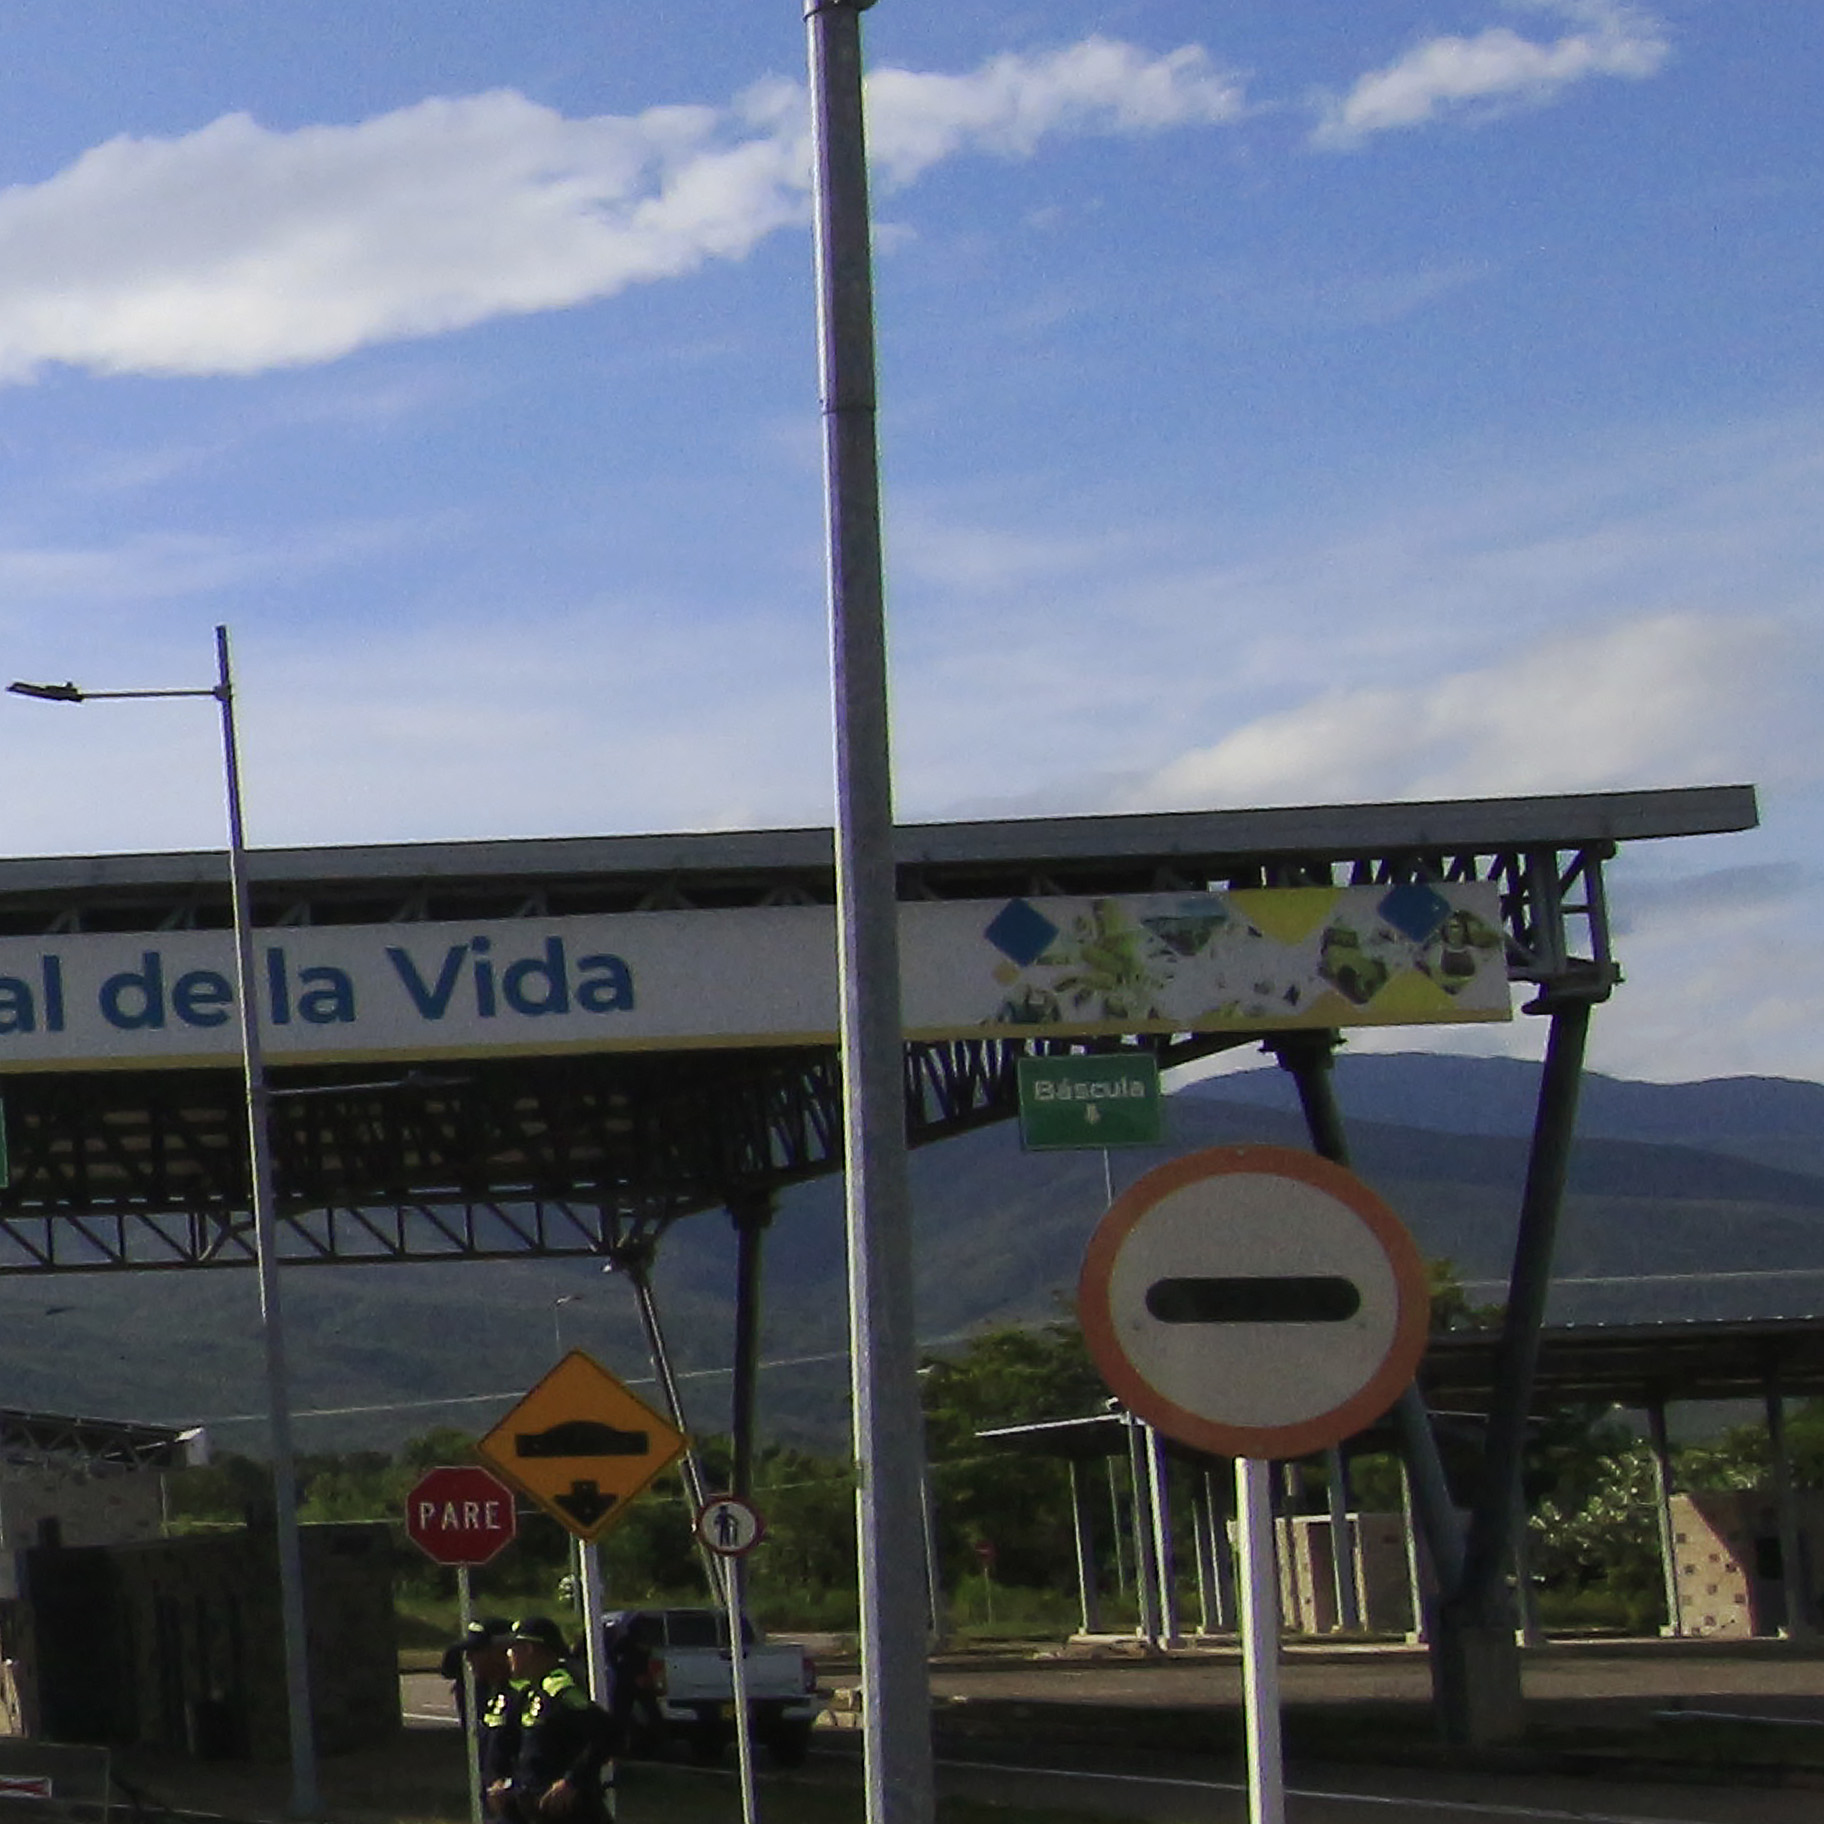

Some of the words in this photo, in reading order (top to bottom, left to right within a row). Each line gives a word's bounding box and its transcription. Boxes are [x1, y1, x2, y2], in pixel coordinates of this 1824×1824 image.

[97, 950, 231, 1032] de
[266, 949, 355, 1026] la
[386, 936, 634, 1022] Vida
[1034, 1078, 1146, 1100] Báscula
[419, 1501, 501, 1531] PARE
